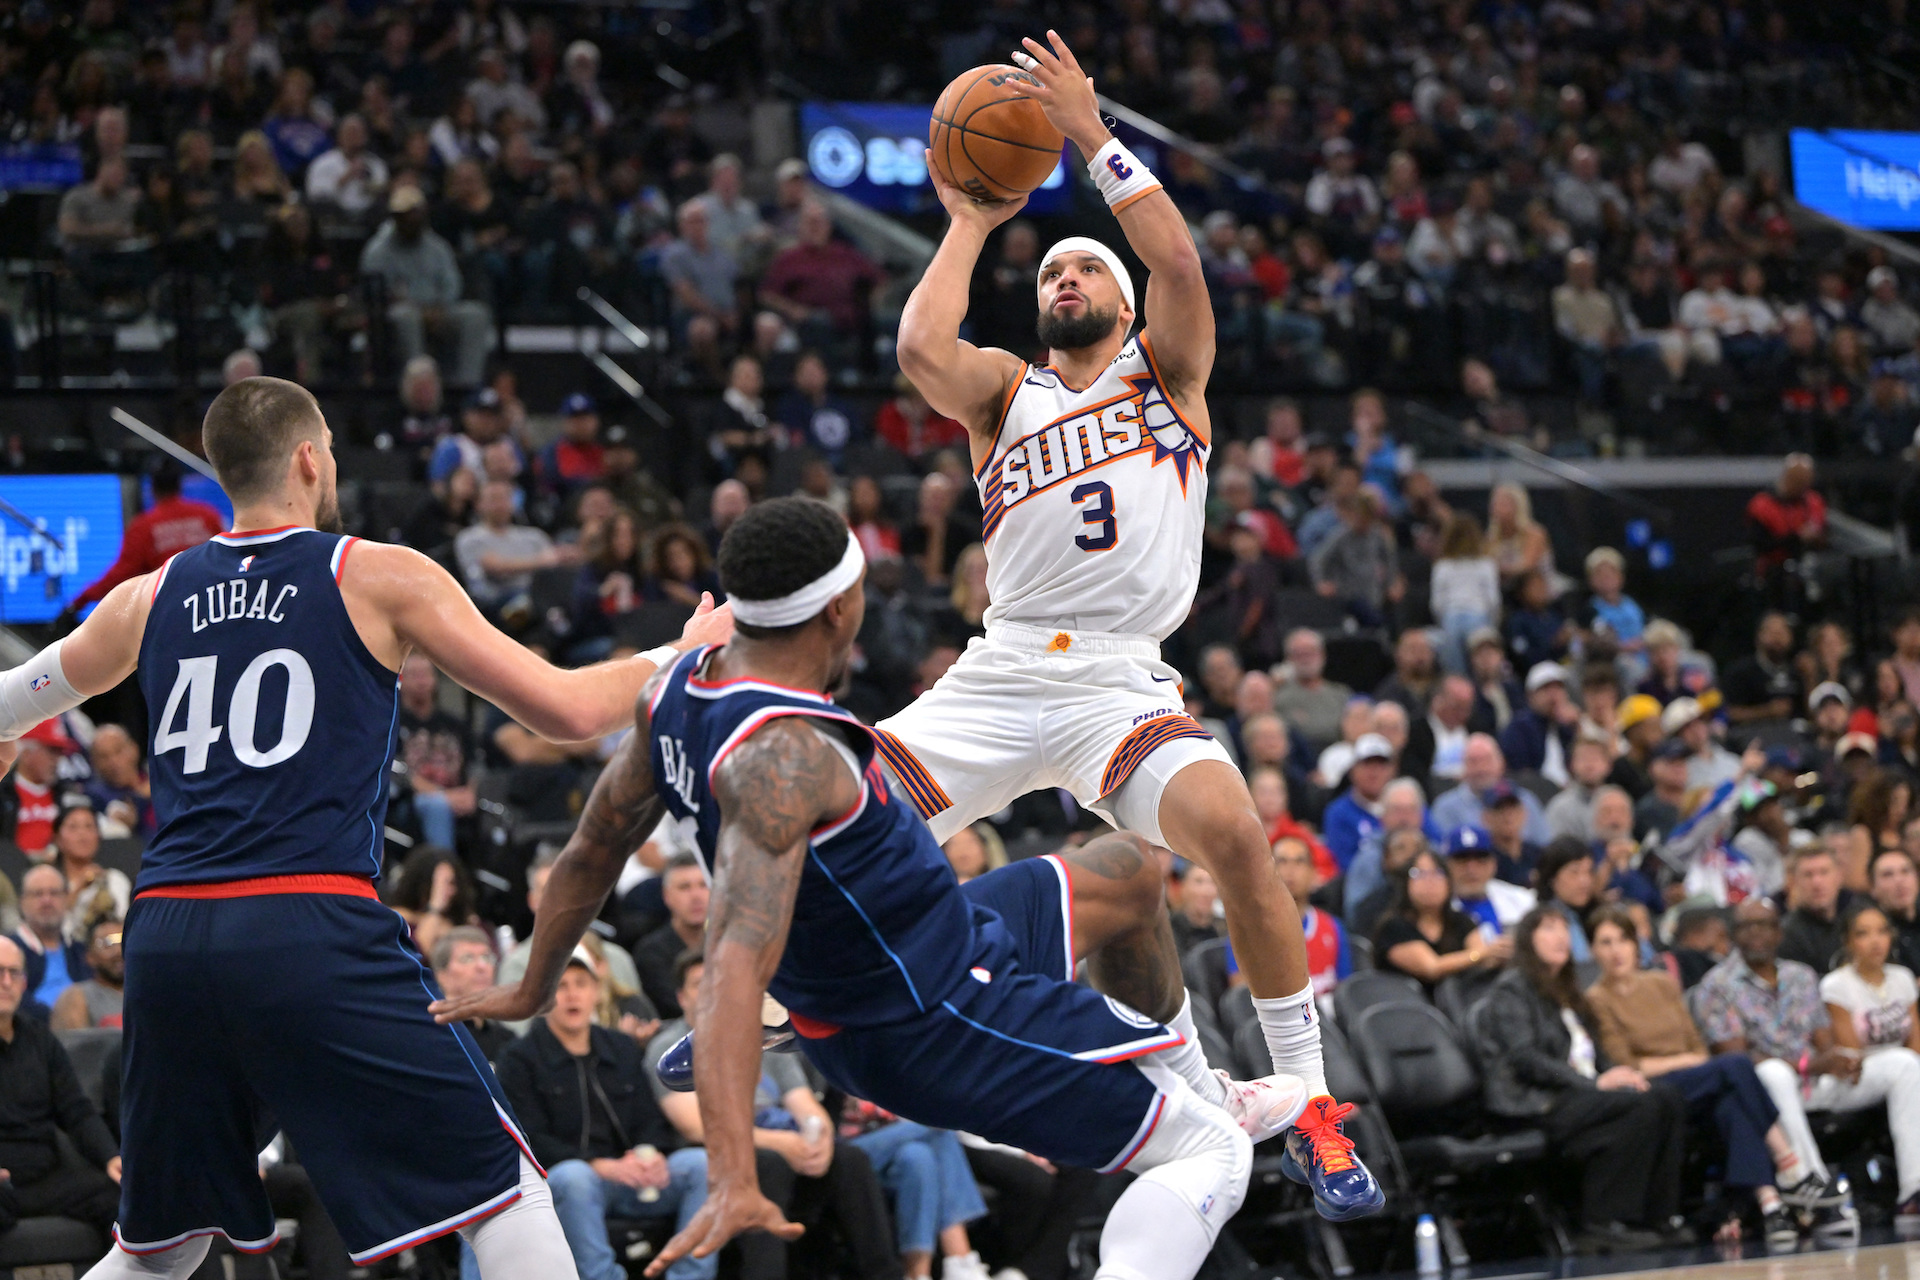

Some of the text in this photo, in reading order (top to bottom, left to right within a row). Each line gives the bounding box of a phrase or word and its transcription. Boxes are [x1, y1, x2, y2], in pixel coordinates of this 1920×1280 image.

[1106, 153, 1133, 180] 3
[1002, 400, 1142, 507] SUNS
[1071, 480, 1118, 552] 3
[183, 578, 298, 633] ZUBAC
[154, 648, 316, 775] 40
